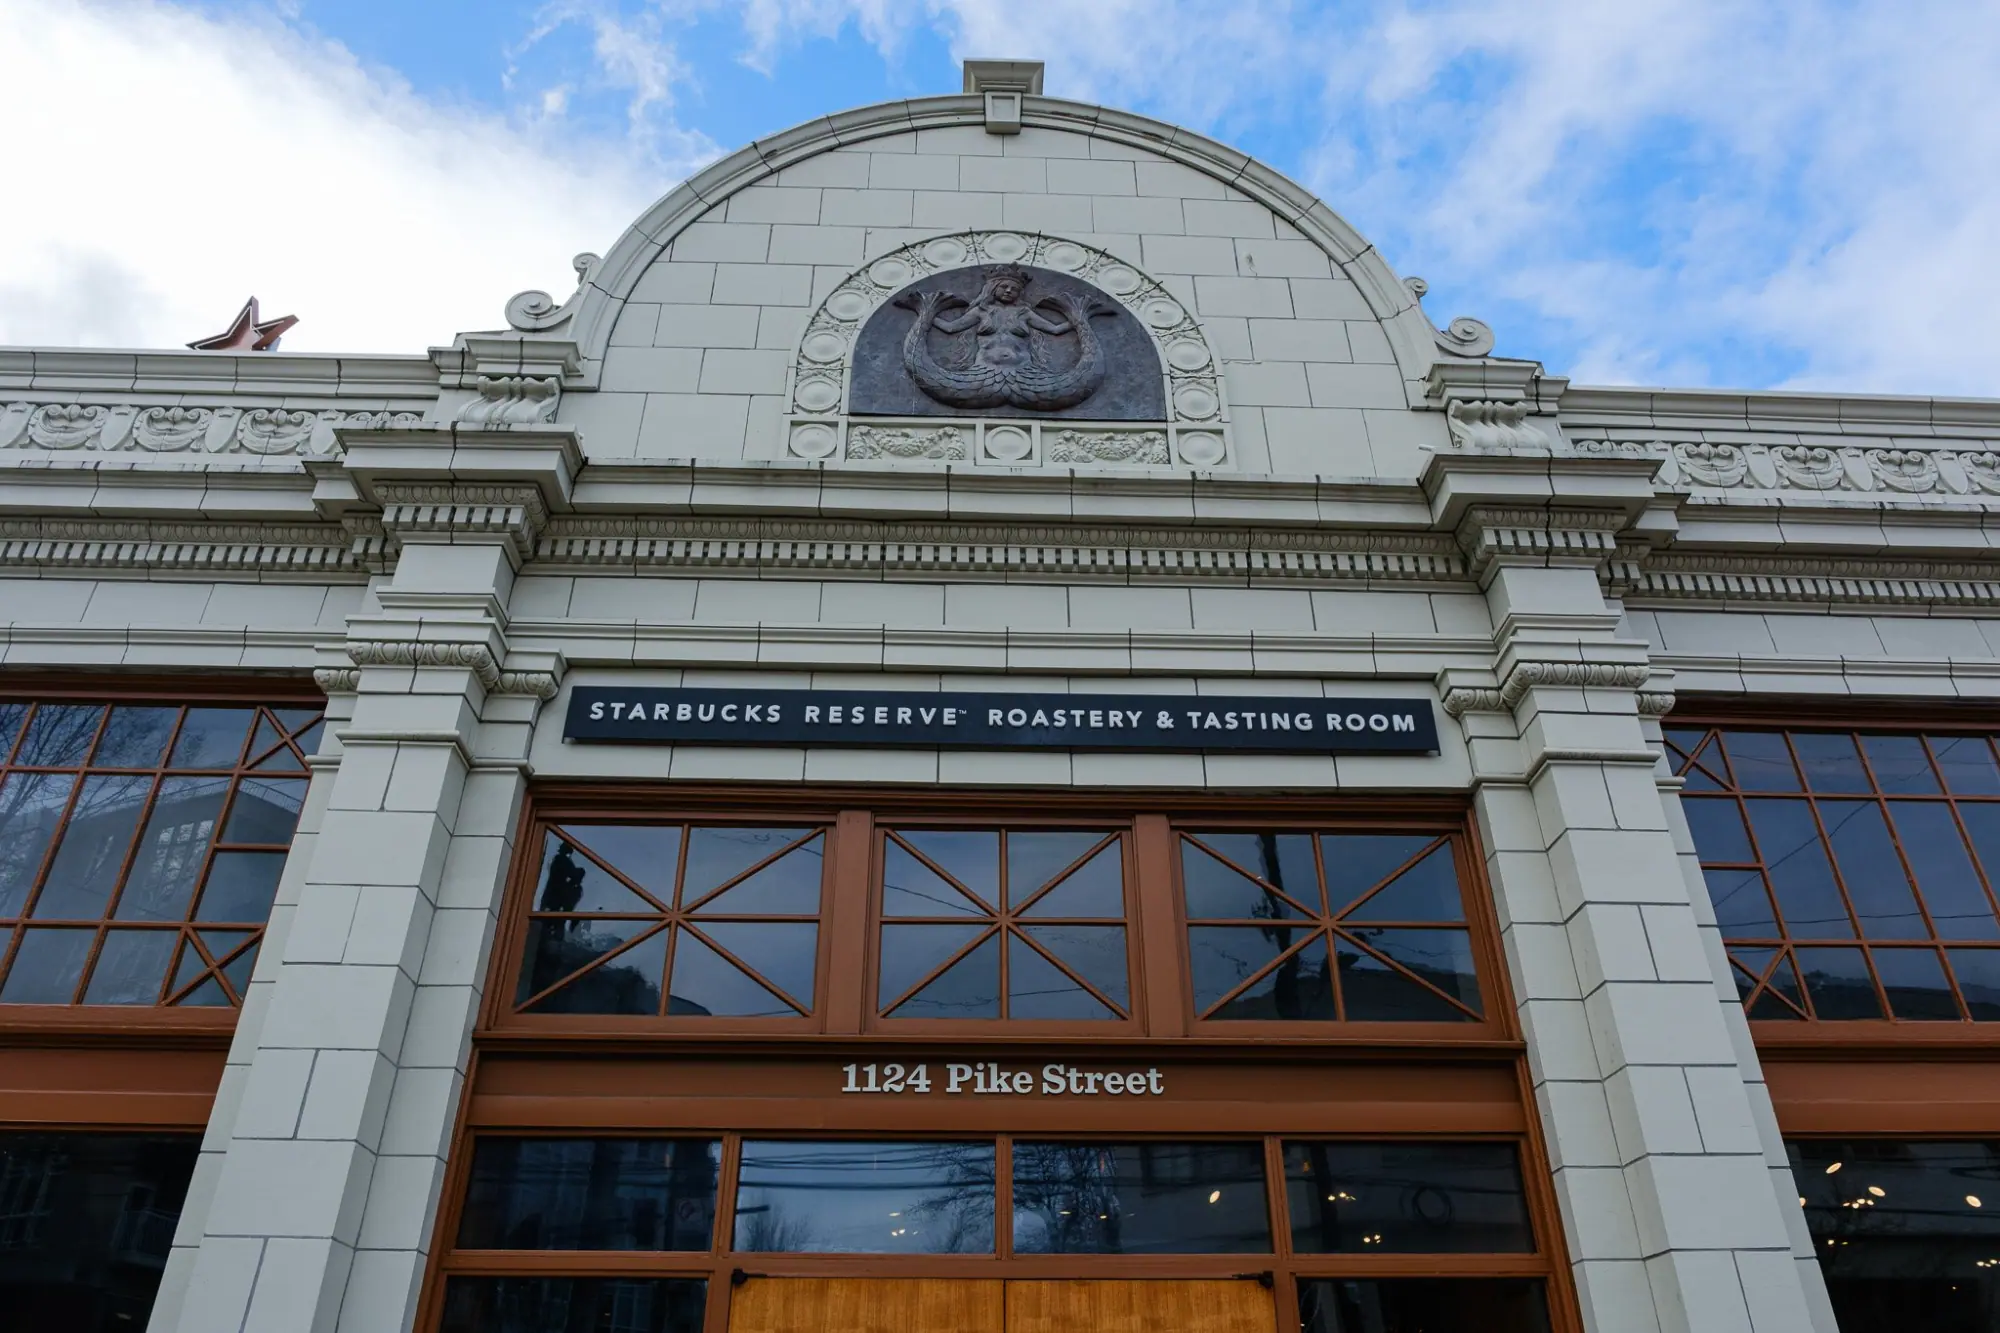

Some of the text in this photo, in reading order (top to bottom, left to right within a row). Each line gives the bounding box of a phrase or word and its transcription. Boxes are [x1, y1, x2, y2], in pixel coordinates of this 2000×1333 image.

[589, 701, 781, 723] STARBUCKS
[988, 708, 1142, 729] ROASTERY
[1156, 710, 1175, 729] &
[1187, 711, 1313, 731] TASTING
[1326, 713, 1416, 732] ROOM
[841, 1062, 1165, 1095] 1124 Pike Street
